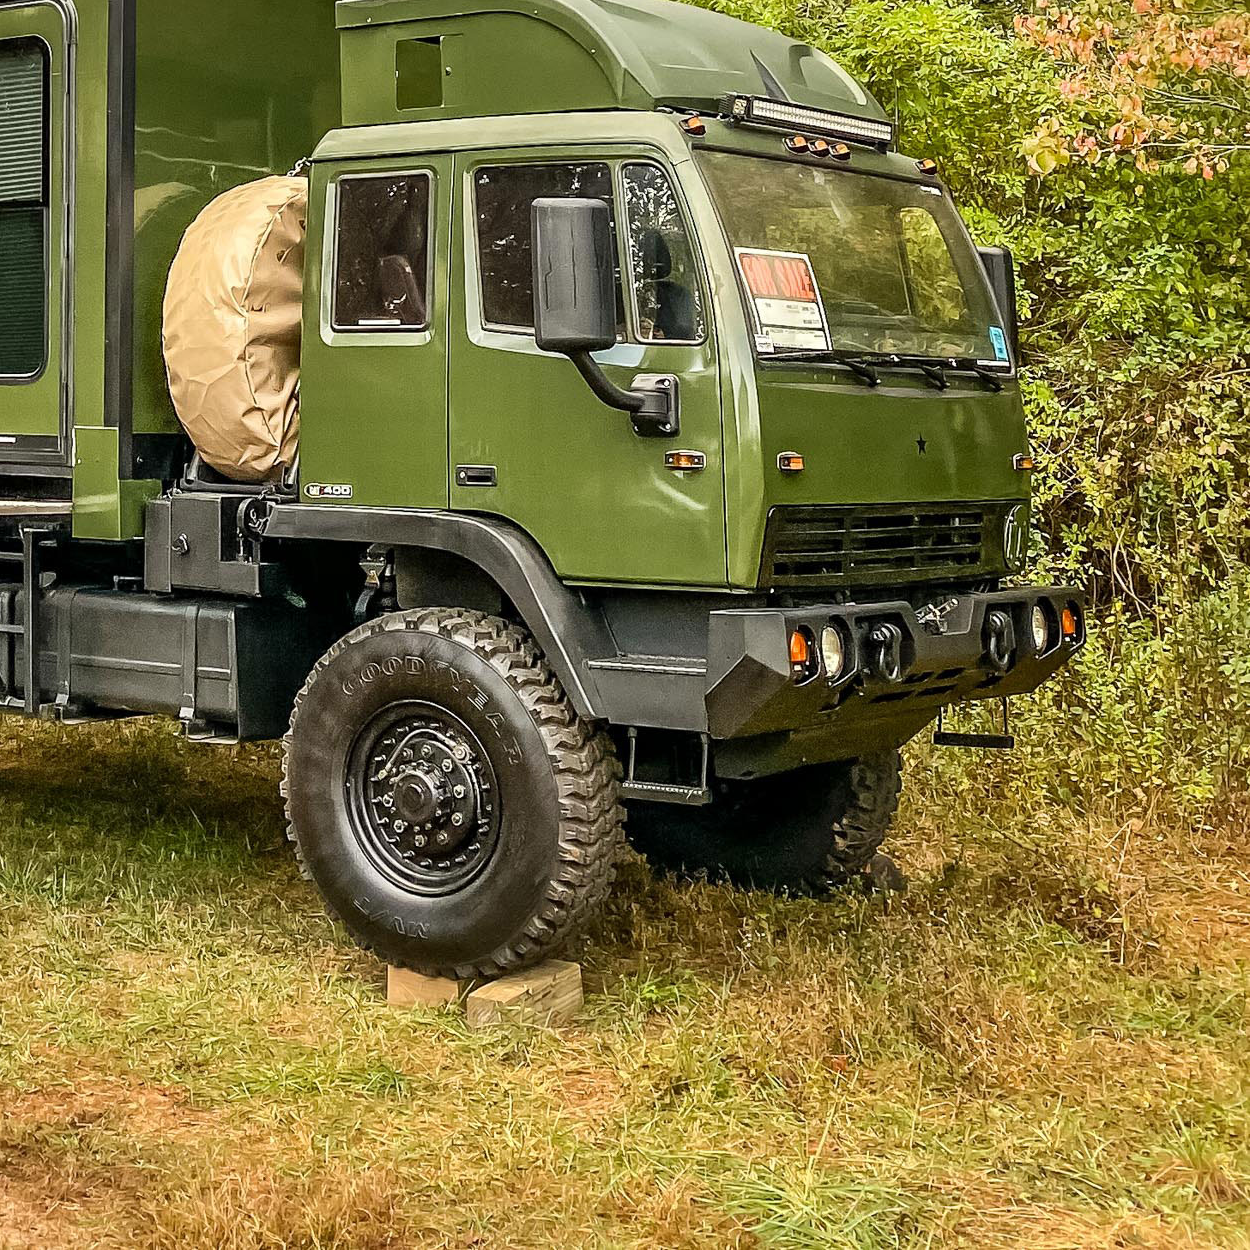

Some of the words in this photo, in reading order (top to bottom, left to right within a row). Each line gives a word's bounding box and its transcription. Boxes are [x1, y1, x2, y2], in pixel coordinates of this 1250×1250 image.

[741, 255, 779, 296] FOR
[774, 258, 817, 300] SALE
[342, 656, 523, 765] GOODYEAR
